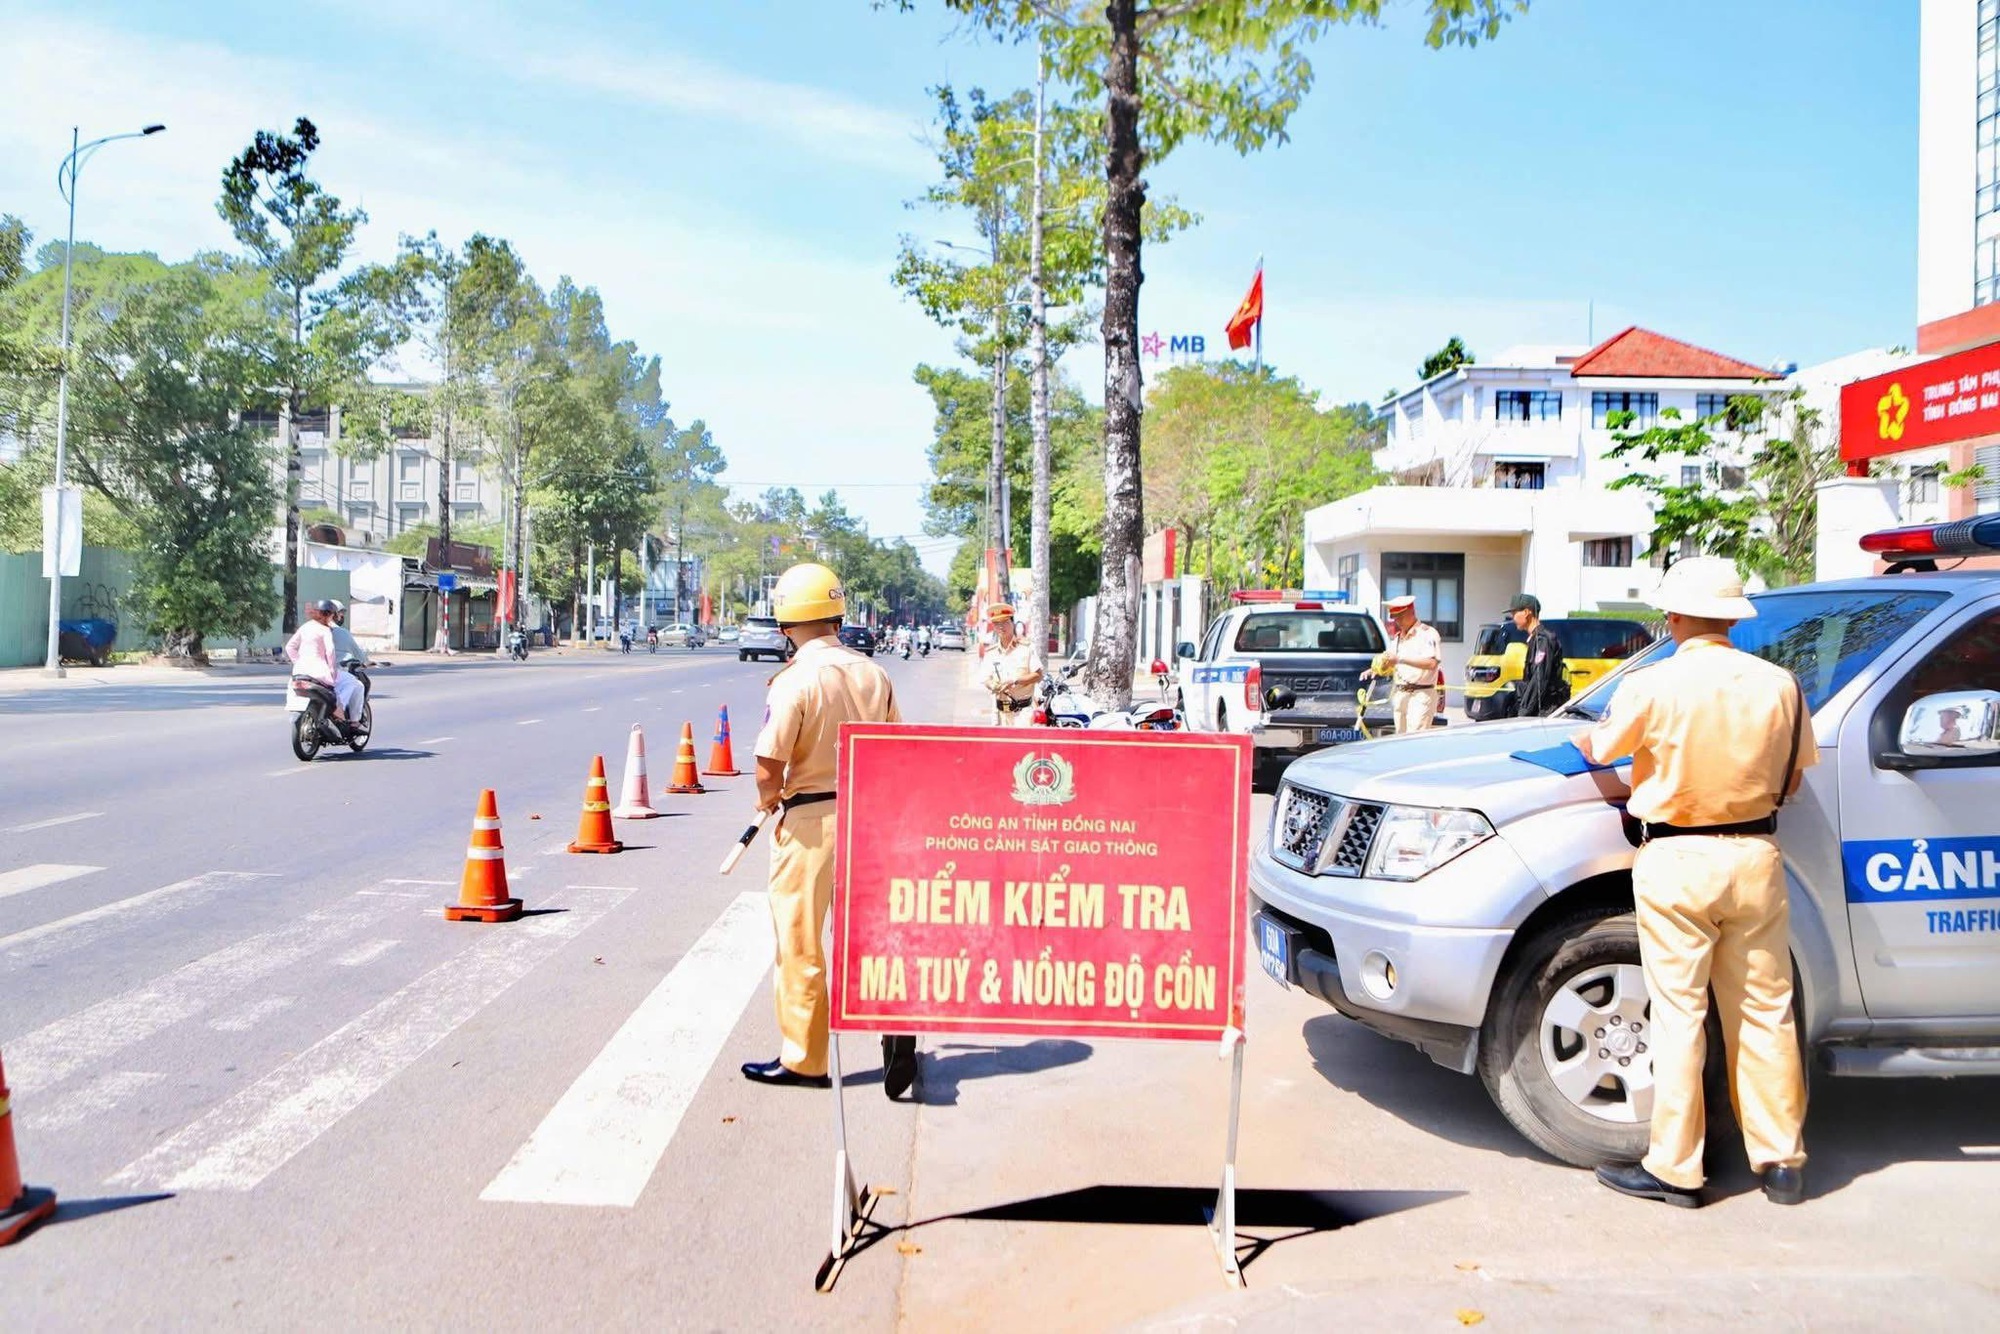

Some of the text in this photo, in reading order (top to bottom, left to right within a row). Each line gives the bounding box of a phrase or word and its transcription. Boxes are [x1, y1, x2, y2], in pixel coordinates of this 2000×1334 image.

[1170, 335, 1205, 353] MB
[1980, 391, 1999, 410] NAI
[949, 812, 1136, 834] CÔNG AN TỈNH ĐỒNG NAI
[925, 834, 1158, 857] PHÒNG CẢNH SÁT GIAO THÔNG
[888, 861, 1192, 931] ĐIỂM KIỂM TRA
[860, 945, 1216, 1019] MA TUÝ & NỒNG ĐỘ CỒN
